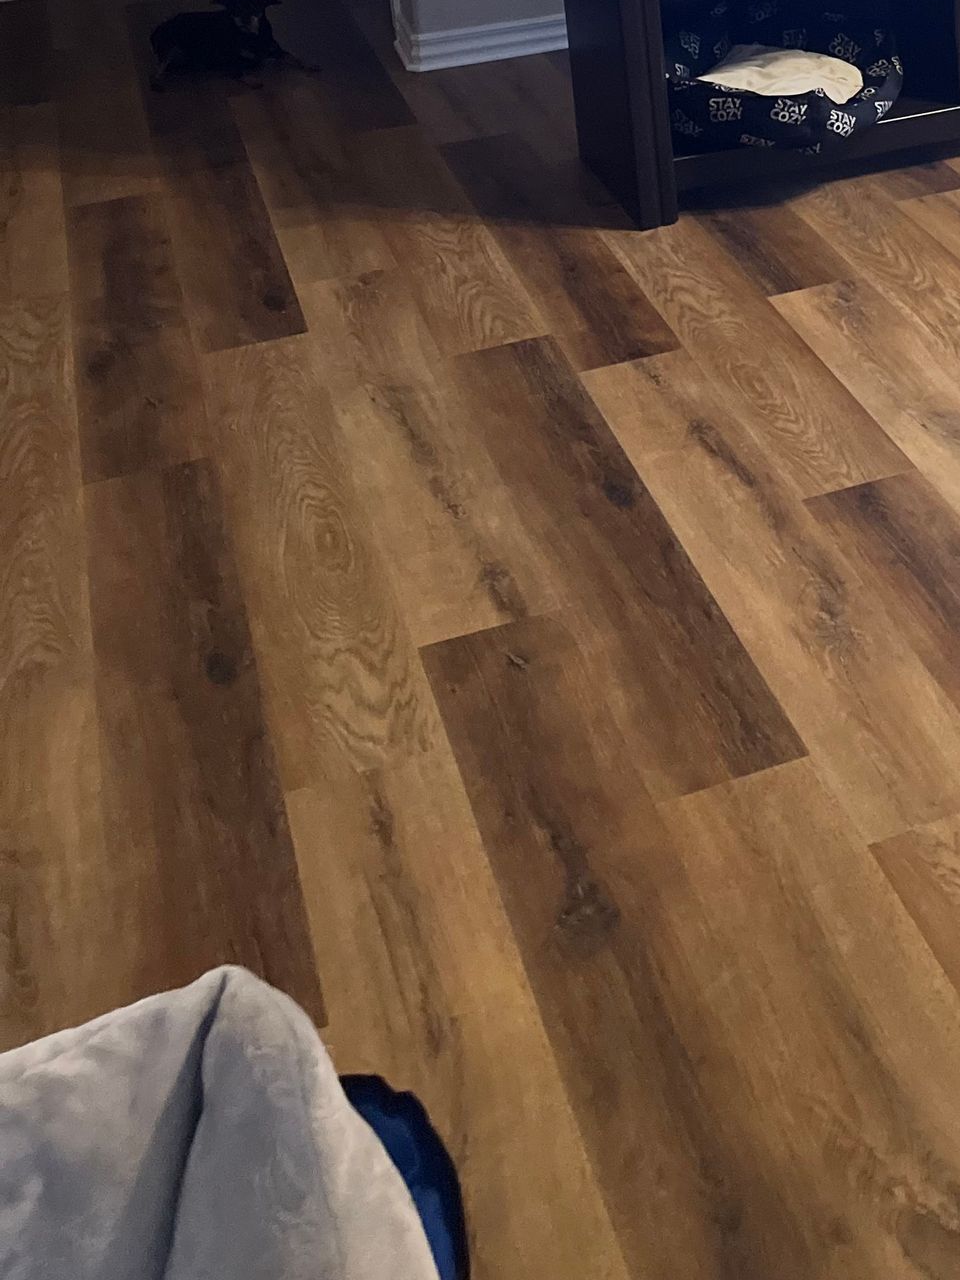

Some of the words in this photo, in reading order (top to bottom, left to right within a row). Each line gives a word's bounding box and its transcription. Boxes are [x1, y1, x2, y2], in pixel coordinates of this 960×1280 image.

[708, 97, 742, 111] STAY
[774, 97, 808, 116] STAY
[709, 107, 744, 122] COZY
[770, 109, 807, 125] COZY
[830, 109, 857, 128] STAY
[826, 120, 854, 138] COZY
